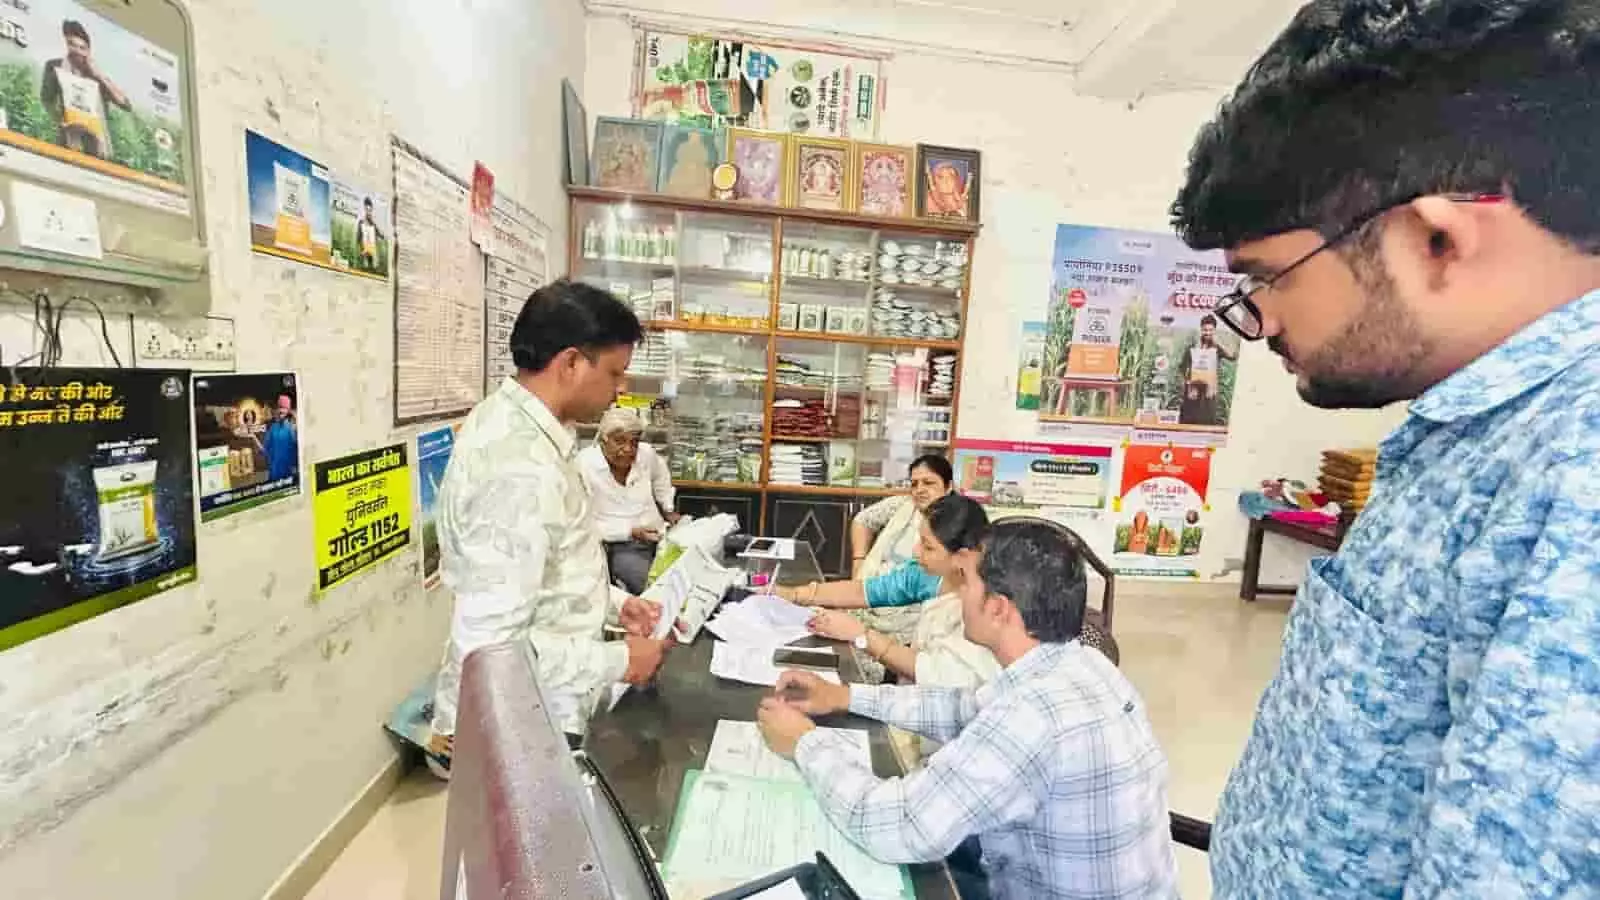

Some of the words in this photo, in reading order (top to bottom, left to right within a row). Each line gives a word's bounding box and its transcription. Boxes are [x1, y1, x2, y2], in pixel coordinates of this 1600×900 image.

[59, 382, 83, 401] की
[72, 403, 96, 421] की
[356, 460, 370, 475] का
[328, 527, 369, 556] गोल्ड
[371, 512, 399, 541] 1152
